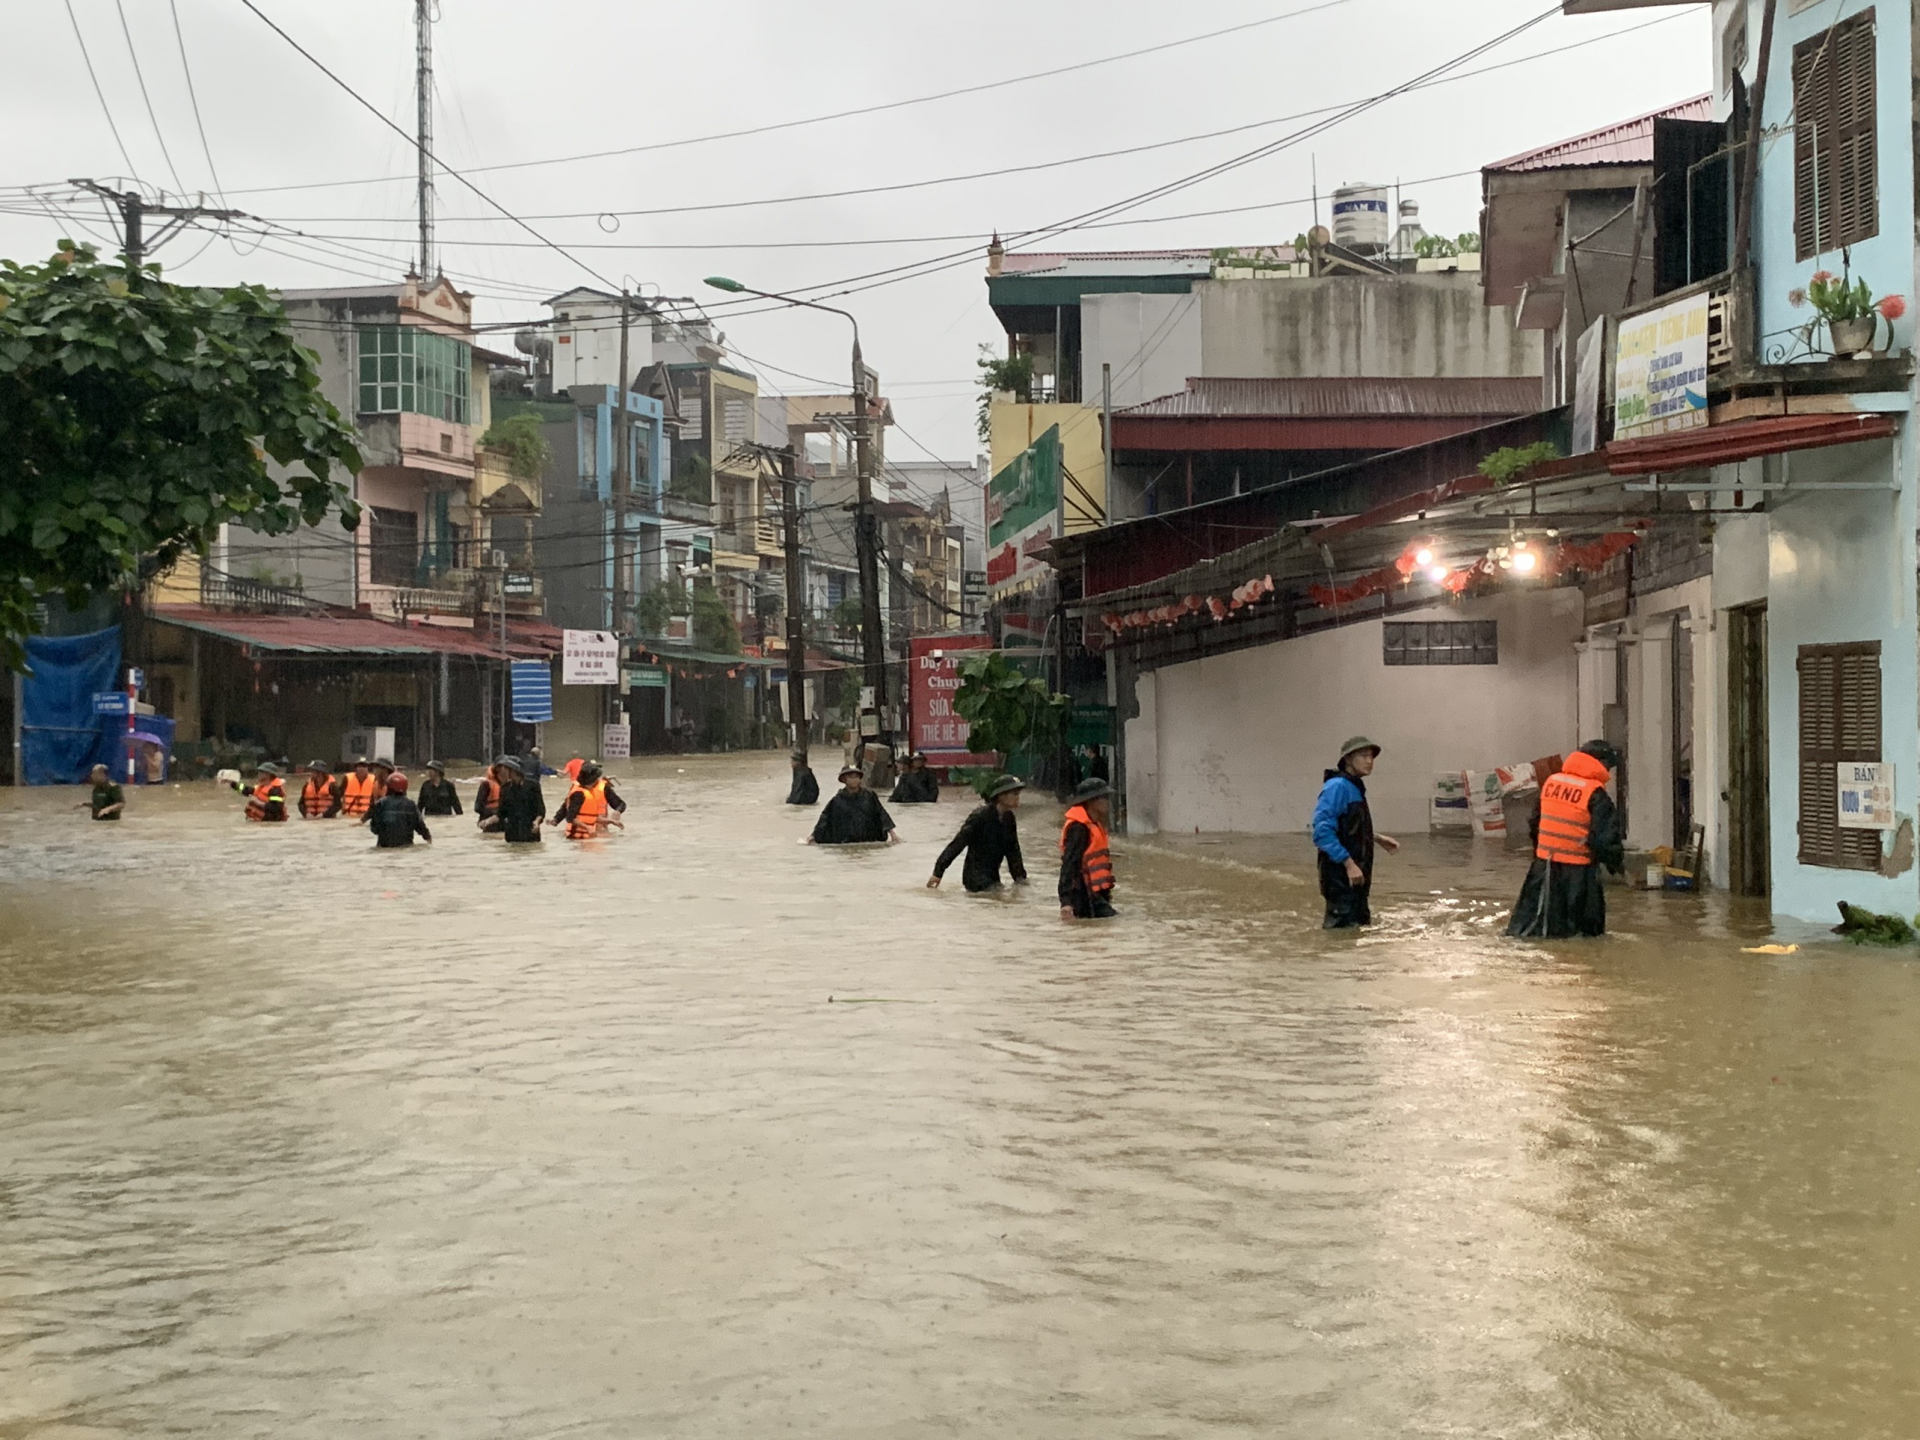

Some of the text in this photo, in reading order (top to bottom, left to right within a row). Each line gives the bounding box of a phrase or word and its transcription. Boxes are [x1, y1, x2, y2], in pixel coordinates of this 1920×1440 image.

[945, 656, 959, 669] Th
[1854, 764, 1875, 781] BÁN
[1544, 782, 1583, 804] CAND
